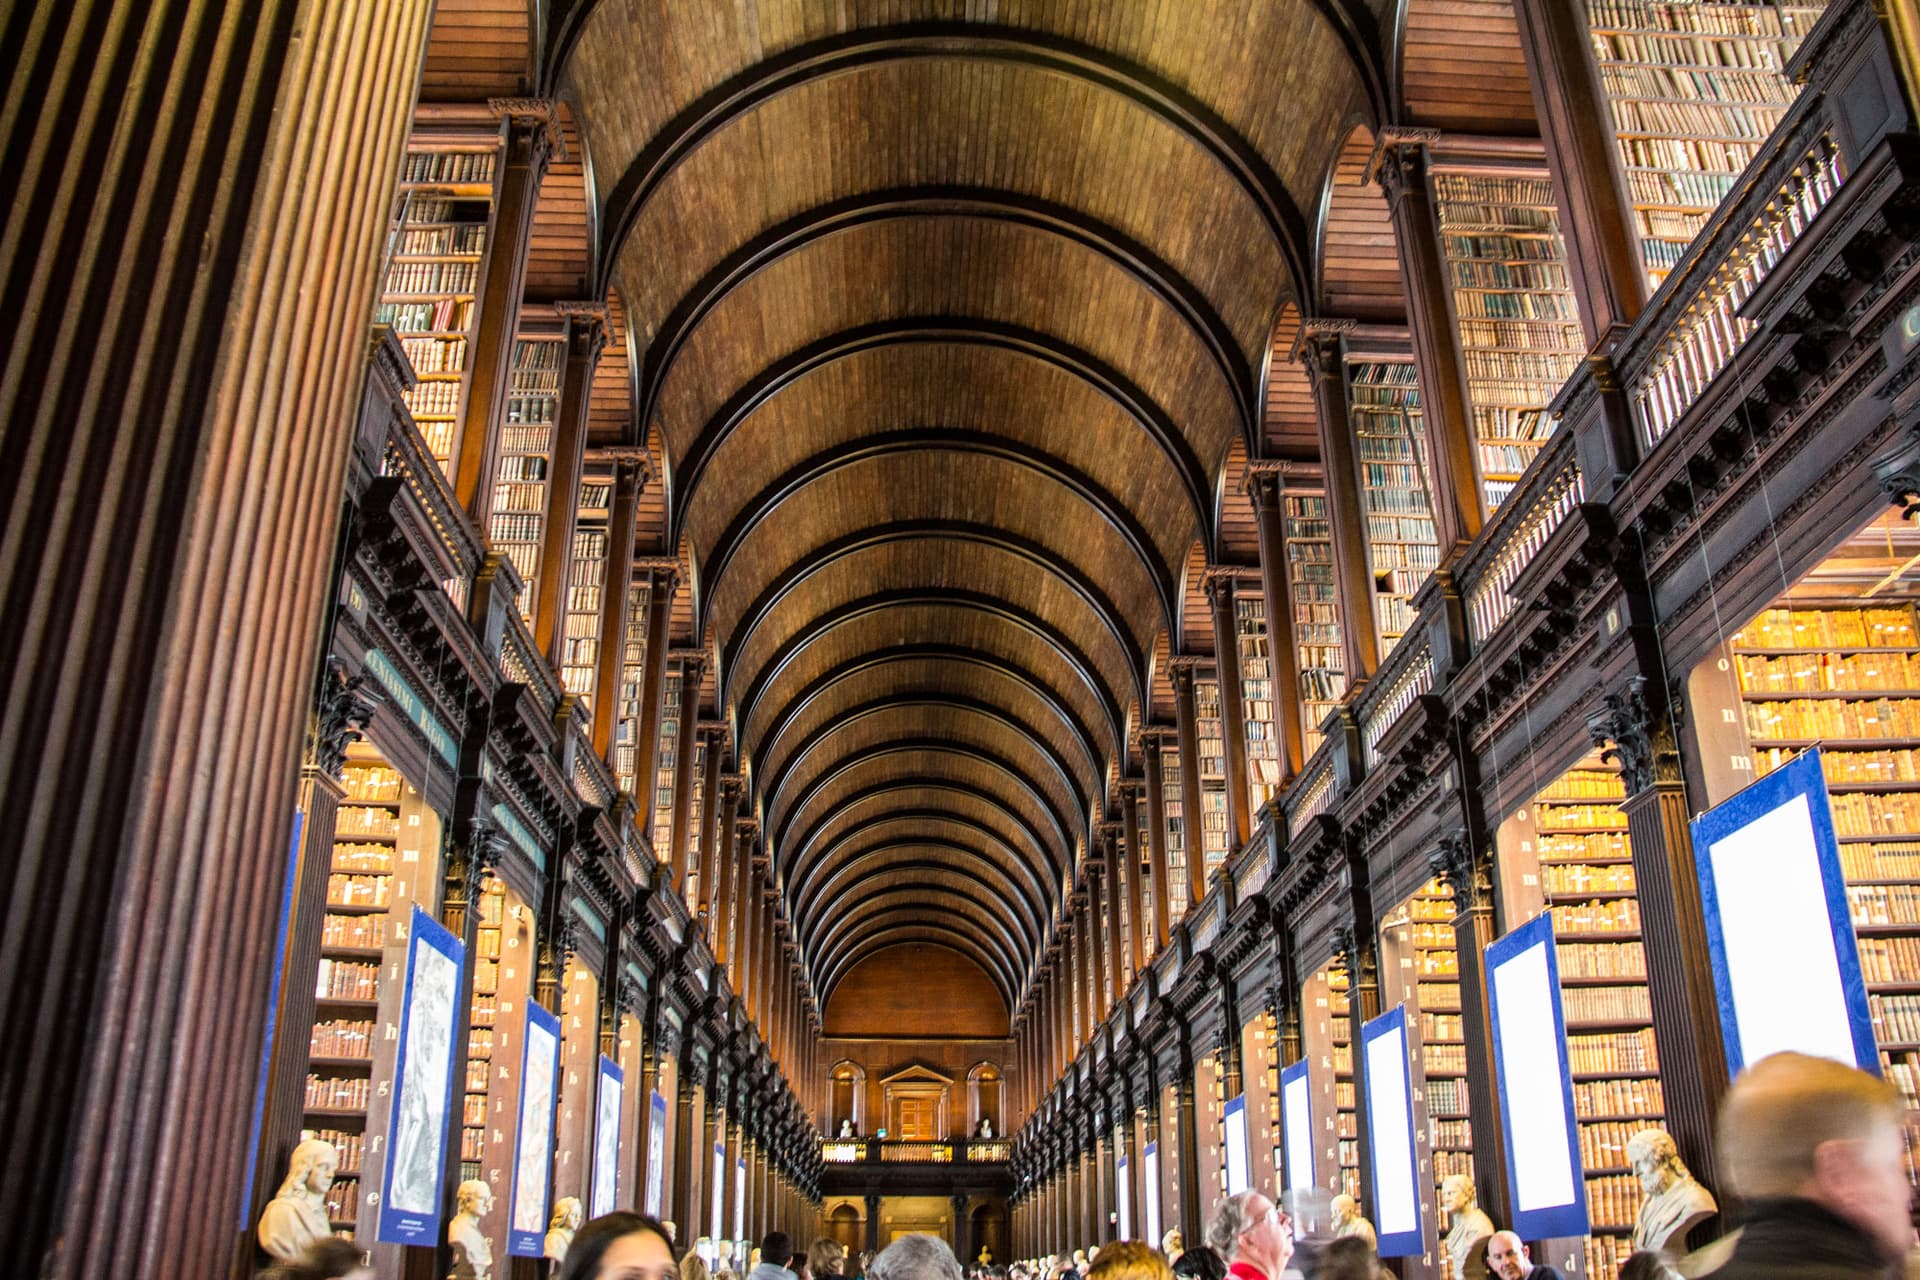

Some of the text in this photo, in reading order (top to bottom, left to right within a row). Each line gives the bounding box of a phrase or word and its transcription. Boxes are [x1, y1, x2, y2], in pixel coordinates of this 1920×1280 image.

[1718, 658, 1729, 671] o
[1722, 708, 1736, 722] n
[1730, 756, 1752, 770] m
